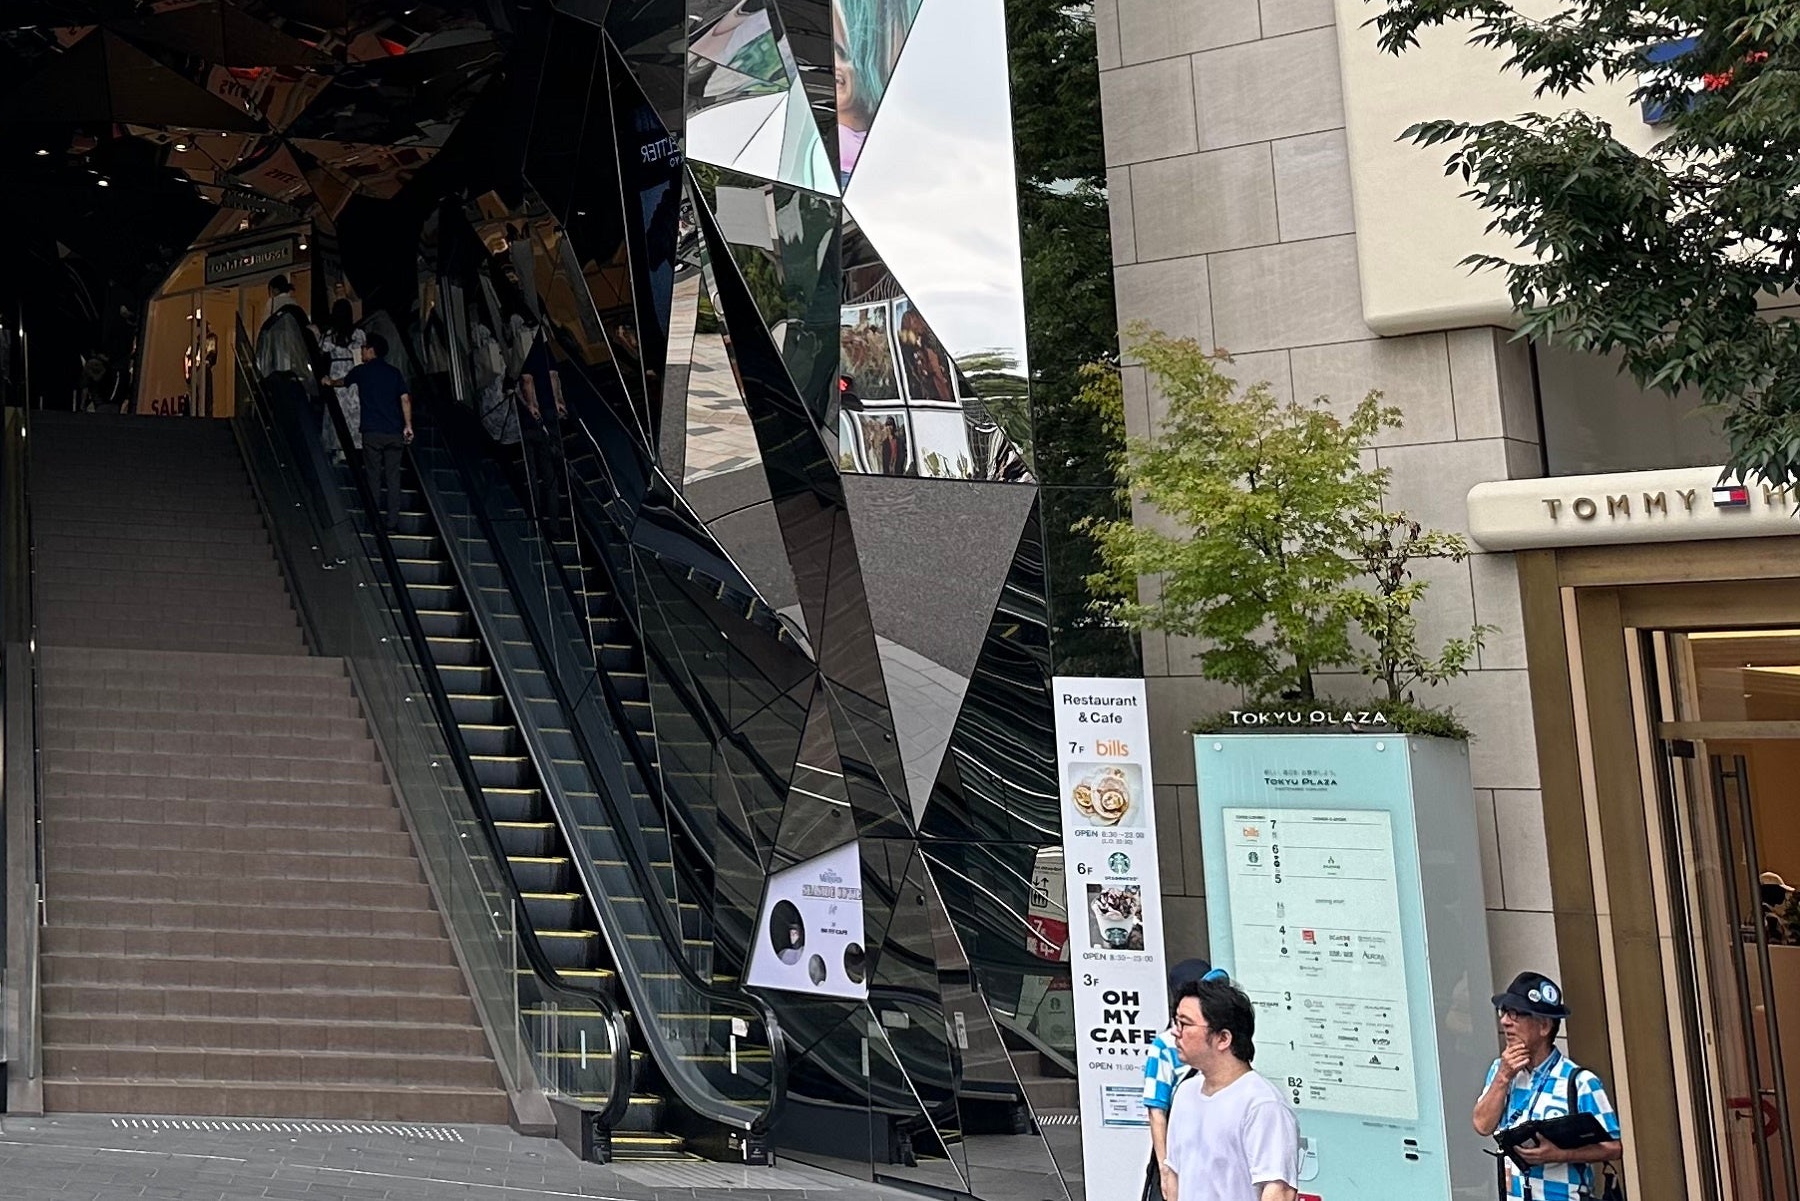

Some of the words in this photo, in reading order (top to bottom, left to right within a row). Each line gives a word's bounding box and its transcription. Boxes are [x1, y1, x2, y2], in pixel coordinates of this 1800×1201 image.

[1541, 488, 1696, 521] TOMMY
[1063, 694, 1137, 706] Restaurant
[1078, 712, 1089, 723] &
[1090, 712, 1122, 724] Cafe
[1230, 710, 1302, 725] TOKYU
[1310, 710, 1388, 724] PLAZA
[1068, 741, 1084, 754] 7F
[1096, 740, 1129, 757] bills
[1264, 777, 1299, 786] TOKYU
[1302, 777, 1337, 786] PLAZA
[1270, 820, 1277, 830] 7
[1075, 829, 1098, 838] OPEN
[1272, 844, 1279, 855] 6
[1077, 862, 1093, 876] 6F
[1275, 874, 1282, 884] 5
[1279, 925, 1286, 935] 4
[1083, 952, 1107, 961] OPEN
[1083, 973, 1100, 987] 3F
[1102, 990, 1140, 1006] OH
[1284, 991, 1291, 1002] 3
[1104, 1009, 1140, 1025] MY
[1090, 1028, 1157, 1045] CAFE
[1289, 1040, 1294, 1051] 1
[1089, 1061, 1113, 1071] OPEN
[1288, 1077, 1303, 1088] B2
